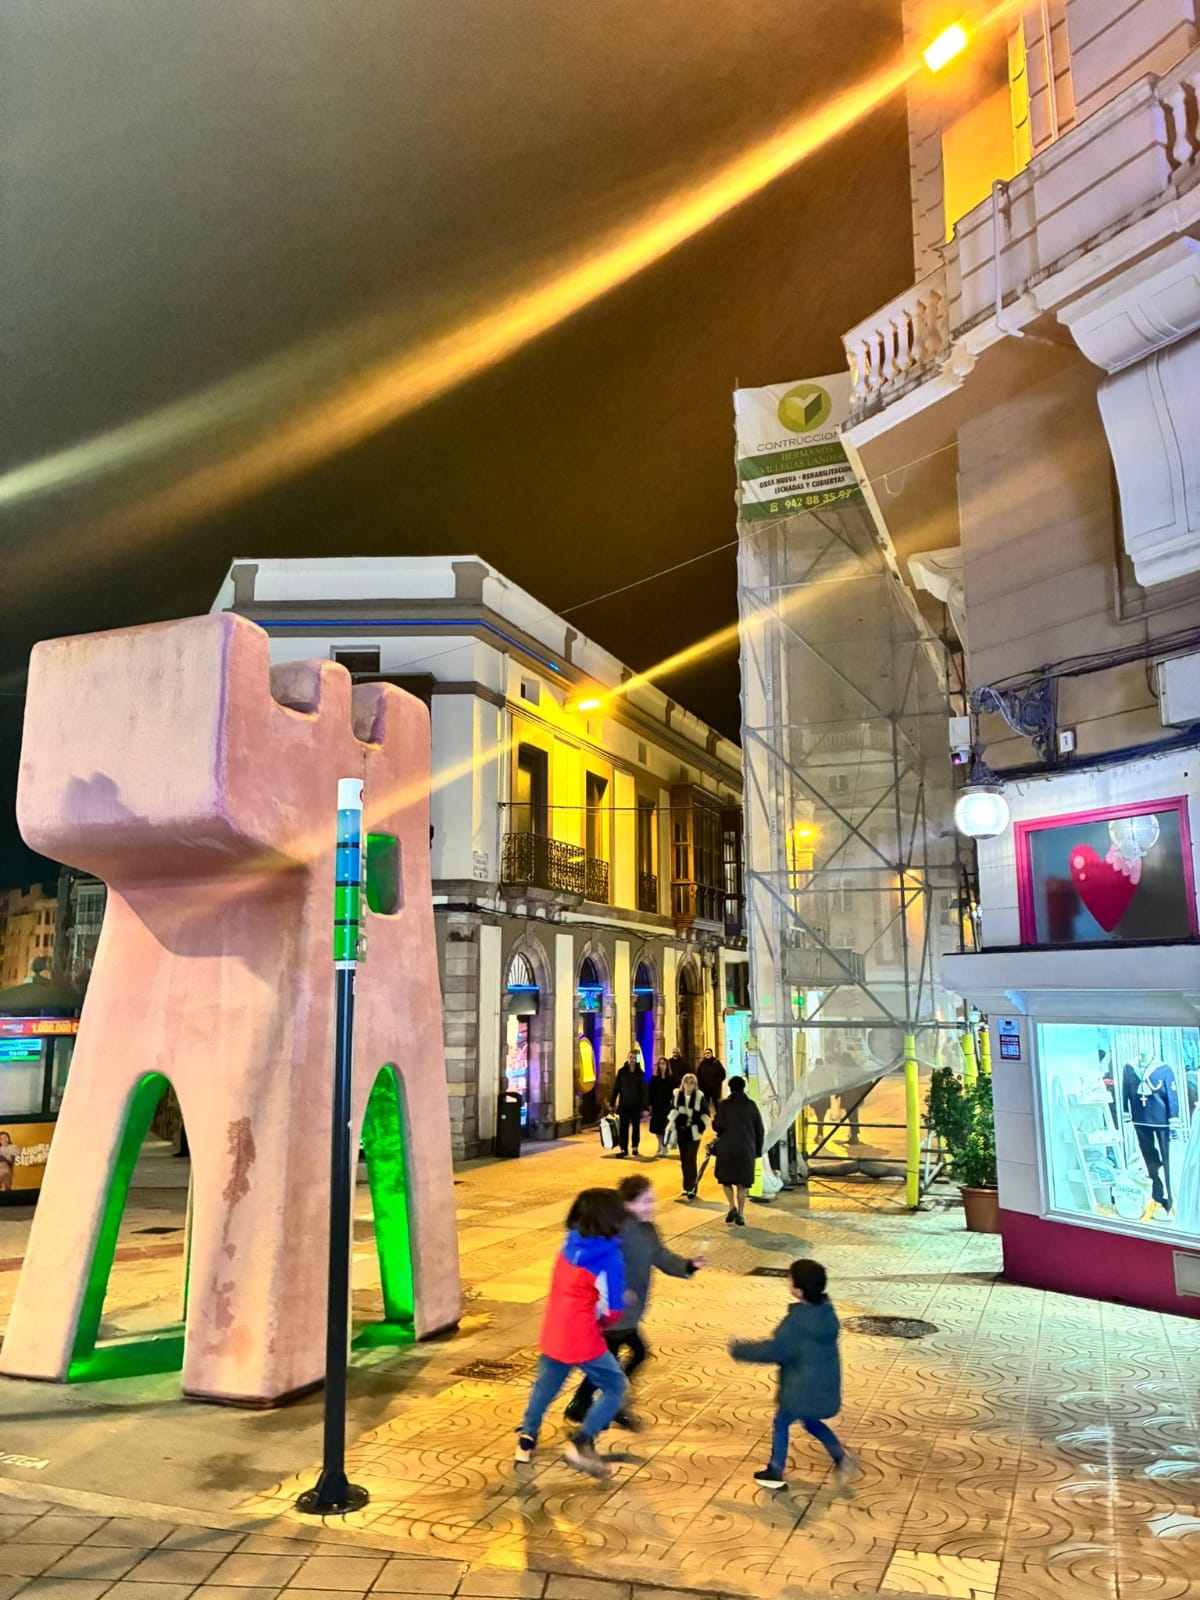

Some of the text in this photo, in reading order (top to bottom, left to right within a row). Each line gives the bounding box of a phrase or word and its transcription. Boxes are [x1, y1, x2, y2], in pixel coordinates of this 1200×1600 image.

[776, 475, 797, 485] NUEVA
[812, 475, 846, 488] CUBIERTAS
[784, 497, 803, 510] 942
[806, 495, 820, 506] 88
[823, 493, 837, 503] 35
